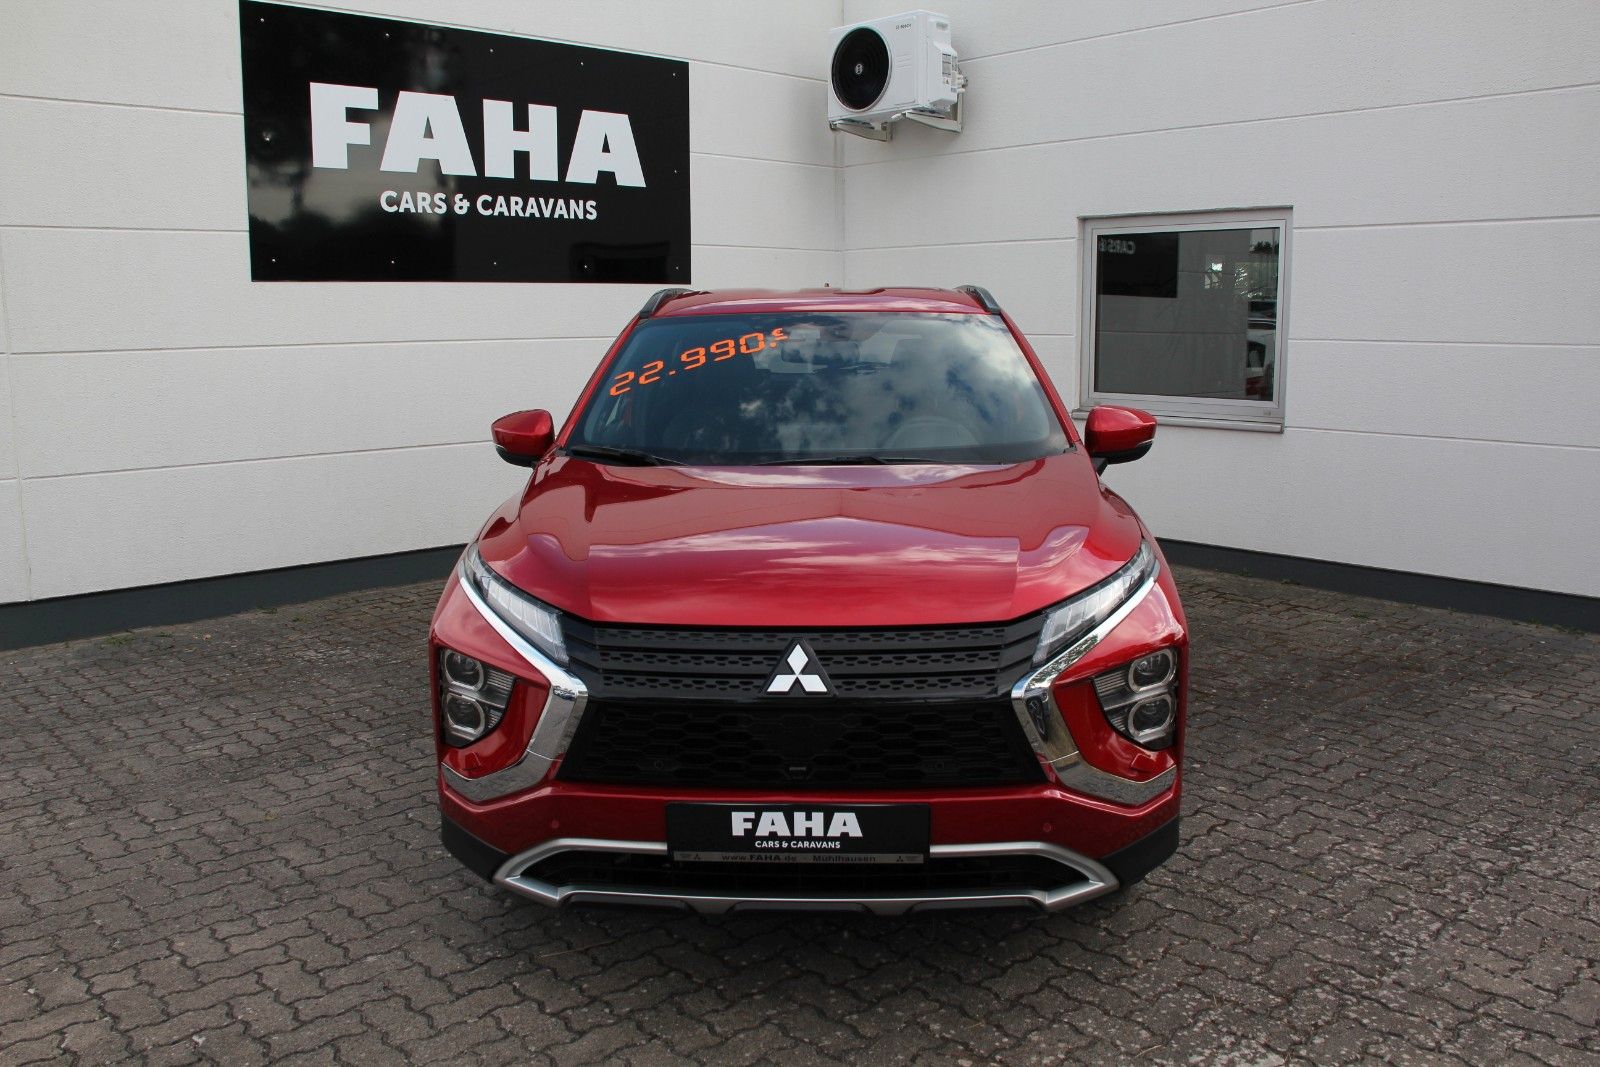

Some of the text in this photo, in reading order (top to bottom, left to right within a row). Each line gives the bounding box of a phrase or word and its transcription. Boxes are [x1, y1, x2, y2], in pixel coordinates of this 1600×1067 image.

[309, 82, 646, 188] FAHA
[379, 190, 598, 221] CARS & CARAVANS
[731, 811, 863, 838] FAHA
[721, 853, 797, 862] www.FAHA.de
[812, 854, 876, 863] Mühlhausen
[755, 840, 780, 848] CARS
[790, 840, 841, 849] CARAVANS
